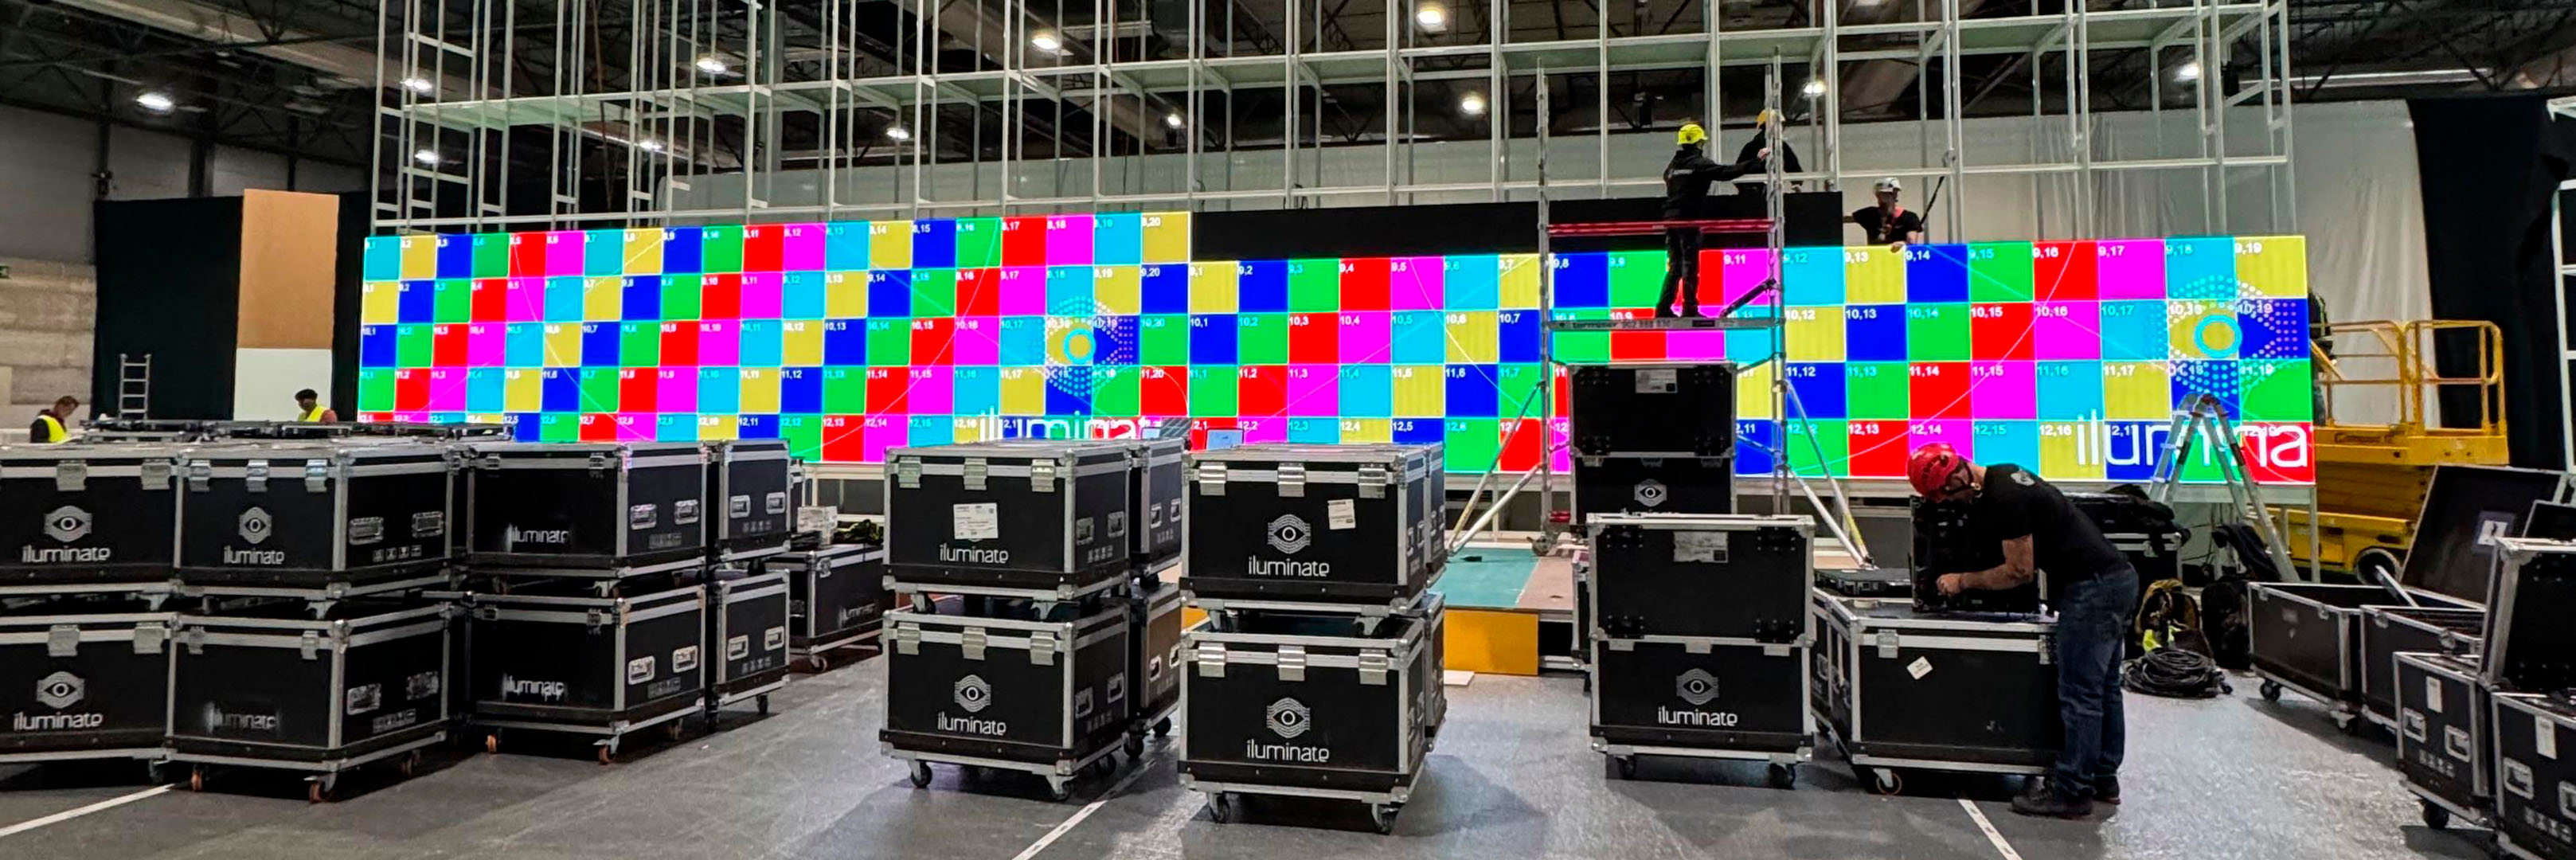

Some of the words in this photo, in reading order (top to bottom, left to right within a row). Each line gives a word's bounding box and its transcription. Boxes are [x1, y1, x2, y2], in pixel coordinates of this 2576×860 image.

[913, 225, 930, 233] 8,15
[1003, 221, 1019, 230] 8,17
[664, 232, 674, 240] 8,9
[744, 229, 759, 238] 8,11
[2098, 246, 2124, 256] 9,17
[2165, 244, 2191, 255] 9,18
[2234, 242, 2261, 252] 9,19
[1845, 252, 1869, 262] 9,13
[1906, 251, 1930, 260] 9,14
[1969, 249, 1994, 259] 9,15
[2034, 248, 2057, 257] 9,16
[1554, 259, 1569, 268] 9,8
[1610, 257, 1625, 267] 9,9
[1725, 255, 1745, 264] 9,11
[1783, 253, 1807, 264] 9,12
[1191, 266, 1202, 275] 9,1
[1240, 265, 1253, 274] 9,2
[1289, 264, 1303, 273] 9,3
[1341, 263, 1354, 272] 9,4
[1392, 262, 1406, 272] 9,5
[1445, 261, 1459, 270] 9,6
[956, 272, 974, 280] 9,16
[1142, 268, 1160, 276] 9,20
[702, 276, 718, 285] 9,10
[870, 273, 885, 282] 9,14
[1784, 309, 1815, 319] 10,12
[1847, 308, 1876, 319] 10,13
[1908, 307, 1939, 318] 10,14
[1971, 307, 2003, 317] 10,15
[2035, 306, 2067, 316] 10,16
[2101, 305, 2132, 315] 10,17
[1190, 317, 1207, 326] 10,1
[1239, 316, 1258, 326] 10,2
[1289, 316, 1308, 325] 10,3
[1341, 315, 1359, 325] 10,4
[1393, 315, 1412, 324] 10,5
[1446, 314, 1467, 323] 10,6
[1500, 313, 1520, 322] 10,7
[661, 323, 676, 332] 10,9
[825, 322, 846, 330] 10,13
[911, 321, 933, 330] 10,15
[781, 369, 802, 378] 11,12
[866, 369, 887, 378] 11,14
[1141, 369, 1164, 377] 11,20
[1190, 369, 1207, 377] 11,1
[1239, 368, 1257, 377] 11,2
[1289, 368, 1308, 377] 11,3
[1341, 368, 1358, 377] 11,4
[1393, 368, 1412, 377] 11,5
[1446, 367, 1465, 377] 11,6
[1500, 367, 1519, 377] 11,7
[1785, 366, 1816, 377] 11,12
[1847, 366, 1877, 376] 11,13
[1909, 366, 1939, 376] 11,14
[1972, 366, 2003, 376] 11,15
[2038, 366, 2068, 376] 11,16
[2103, 366, 2135, 376] 11,17
[739, 417, 758, 426] 12,11
[823, 417, 845, 426] 12,13
[1193, 421, 1206, 430] 2,1
[1238, 421, 1257, 430] 12,2
[1288, 421, 1308, 431] 12,3
[1341, 421, 1360, 431] 12,4
[1394, 421, 1413, 431] 12,5
[1736, 423, 1754, 432] 2,11
[1786, 423, 1816, 433] 12,2
[1849, 424, 1878, 434] 12,13
[1910, 424, 1940, 434] 12,14
[1974, 424, 2006, 435] 12,15
[2040, 425, 2071, 436] 12,16
[22, 544, 111, 564] iluminate
[224, 545, 285, 565] iluminate
[940, 542, 1009, 564] iluminate
[1248, 556, 1330, 577] iluminate
[14, 711, 104, 731] iluminate
[1658, 706, 1738, 726] iluminate
[937, 712, 1007, 736] iluminate
[1246, 740, 1329, 763] iluminate
